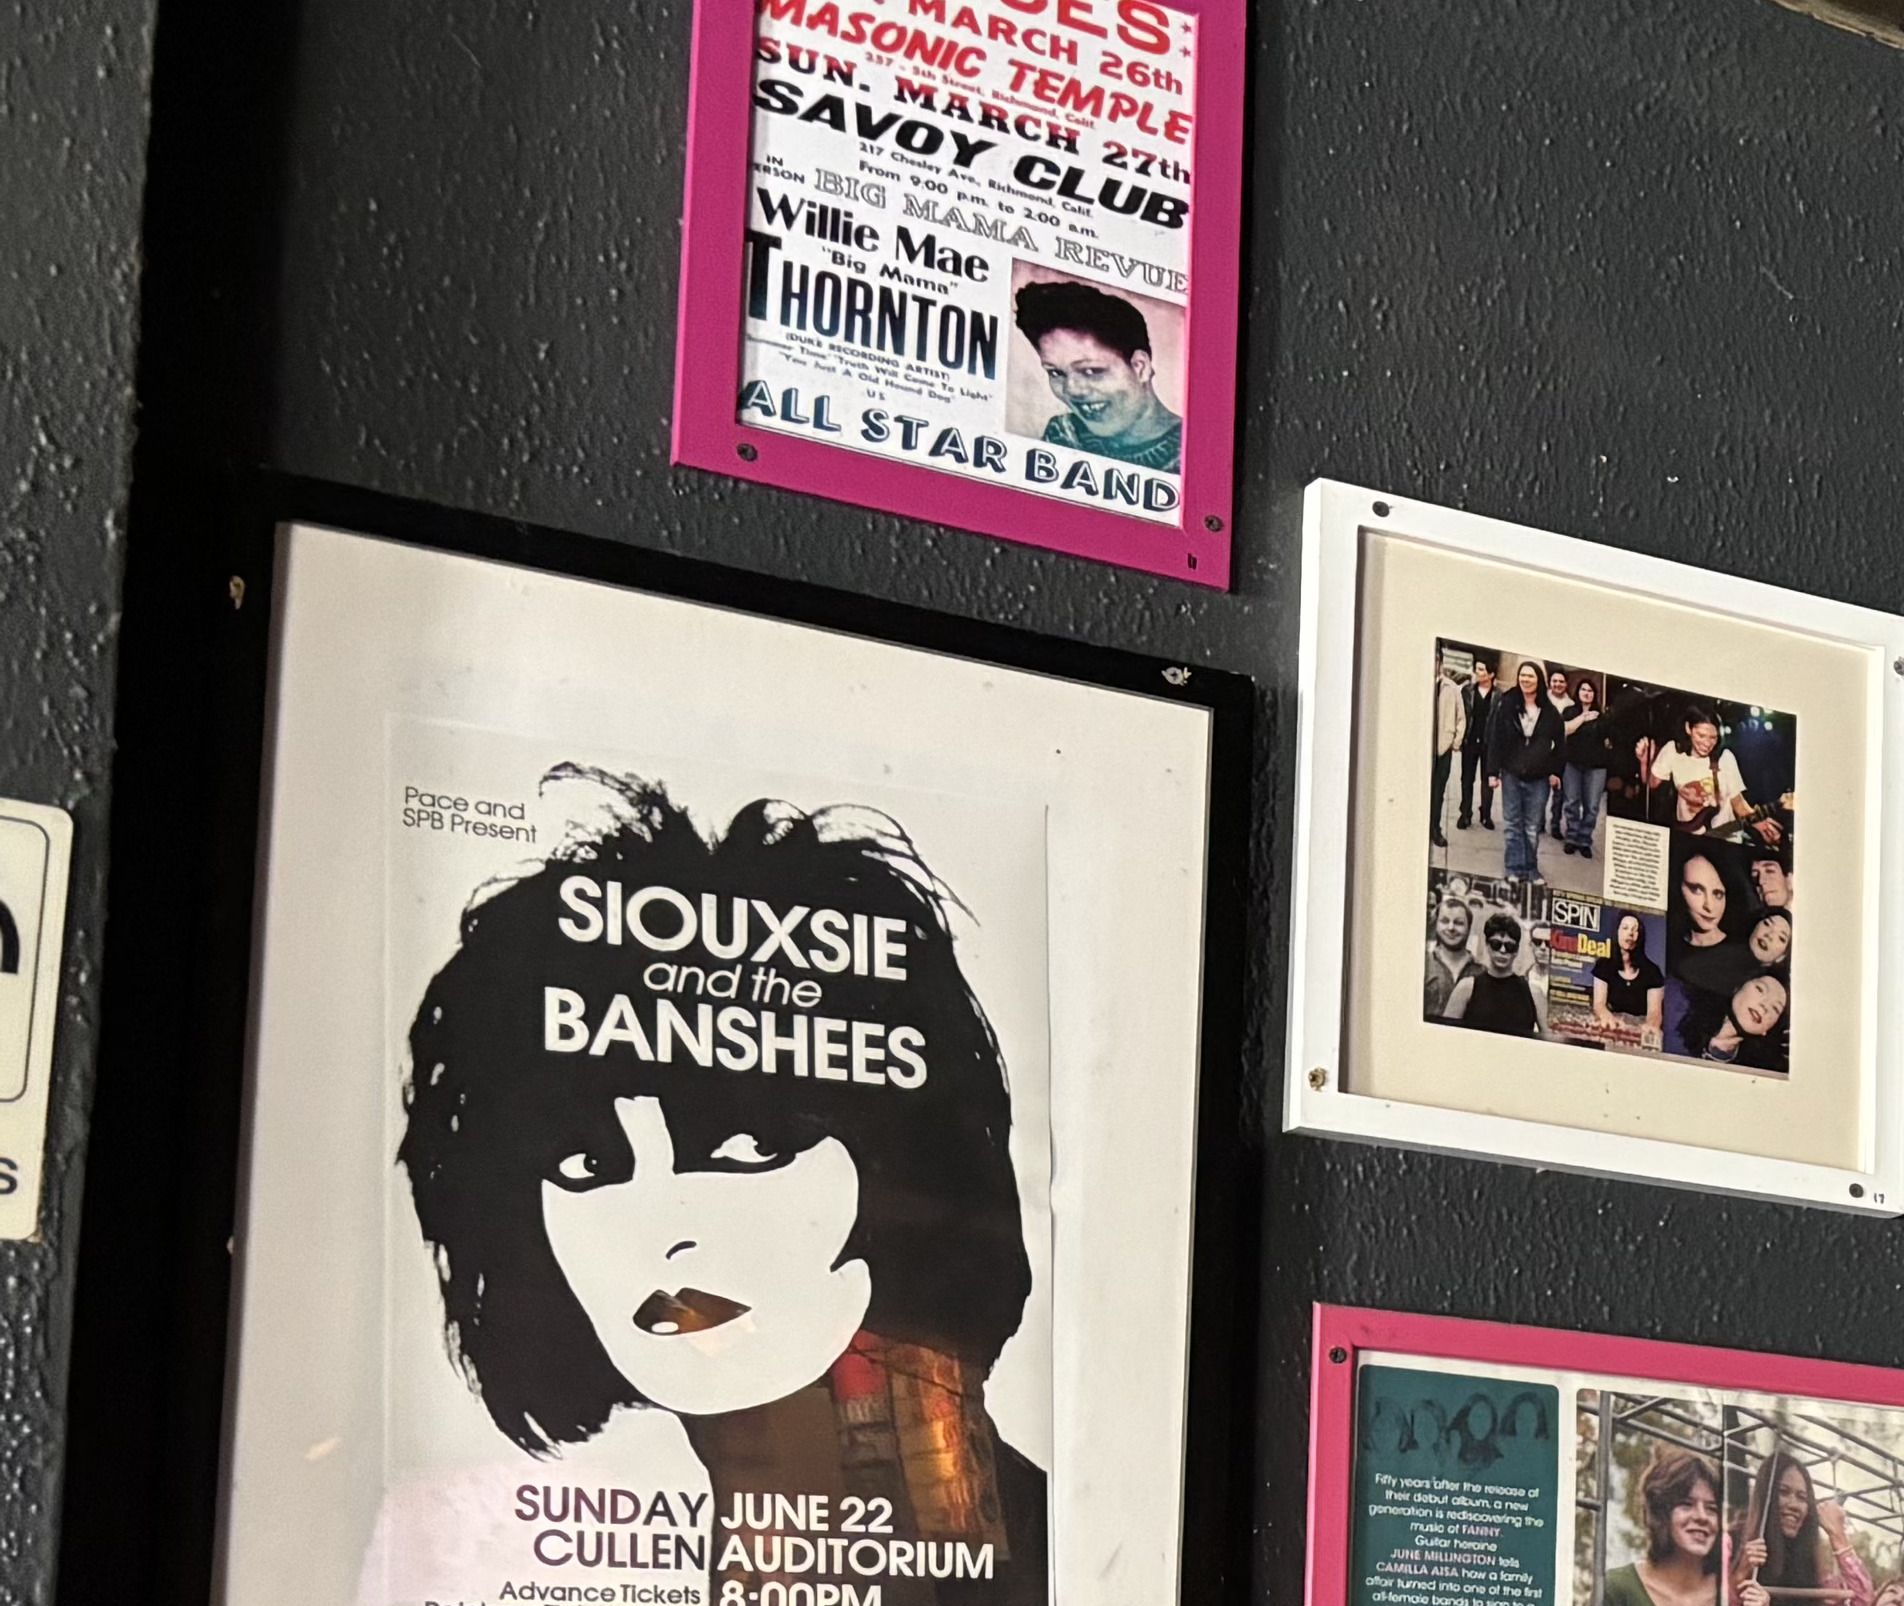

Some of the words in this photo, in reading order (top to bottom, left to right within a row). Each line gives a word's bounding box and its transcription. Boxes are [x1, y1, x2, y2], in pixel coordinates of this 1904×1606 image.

[758, 0, 987, 77] MASONIC
[1007, 59, 1193, 144] TEMPLE
[909, 0, 1078, 64] MARCH
[1099, 52, 1184, 96] 26th
[753, 79, 999, 168] SAVOY
[1013, 155, 1189, 229] CLUB
[758, 37, 869, 92] SUN.
[895, 75, 1079, 154] MARCH
[1102, 141, 1190, 184] 27th
[766, 154, 784, 168] IN
[756, 187, 879, 252] Willie
[896, 225, 989, 282] Mae
[814, 168, 886, 209] BIG
[903, 193, 1038, 252] MAMA
[1055, 237, 1188, 295] REVUE
[744, 228, 998, 380] THORNTON
[738, 379, 841, 431] ALL
[861, 408, 1007, 473] STAR
[1024, 448, 1180, 513] BAND
[402, 807, 444, 831] SPB
[451, 812, 537, 844] Present
[404, 786, 468, 813] Pace
[475, 797, 525, 820] and
[558, 875, 906, 981] SIOUXSIE
[1554, 901, 1598, 930] SPIN
[642, 960, 741, 999] and
[750, 967, 822, 1008] the
[544, 986, 927, 1089] BANSHEES
[514, 1484, 708, 1529] SUNDAY
[720, 1492, 829, 1531] JUNE
[840, 1496, 894, 1534] 22
[534, 1530, 706, 1571] CULLEN
[718, 1535, 994, 1579] AUDITORIUM
[500, 1581, 615, 1603] Advance
[621, 1584, 700, 1605] Tickets
